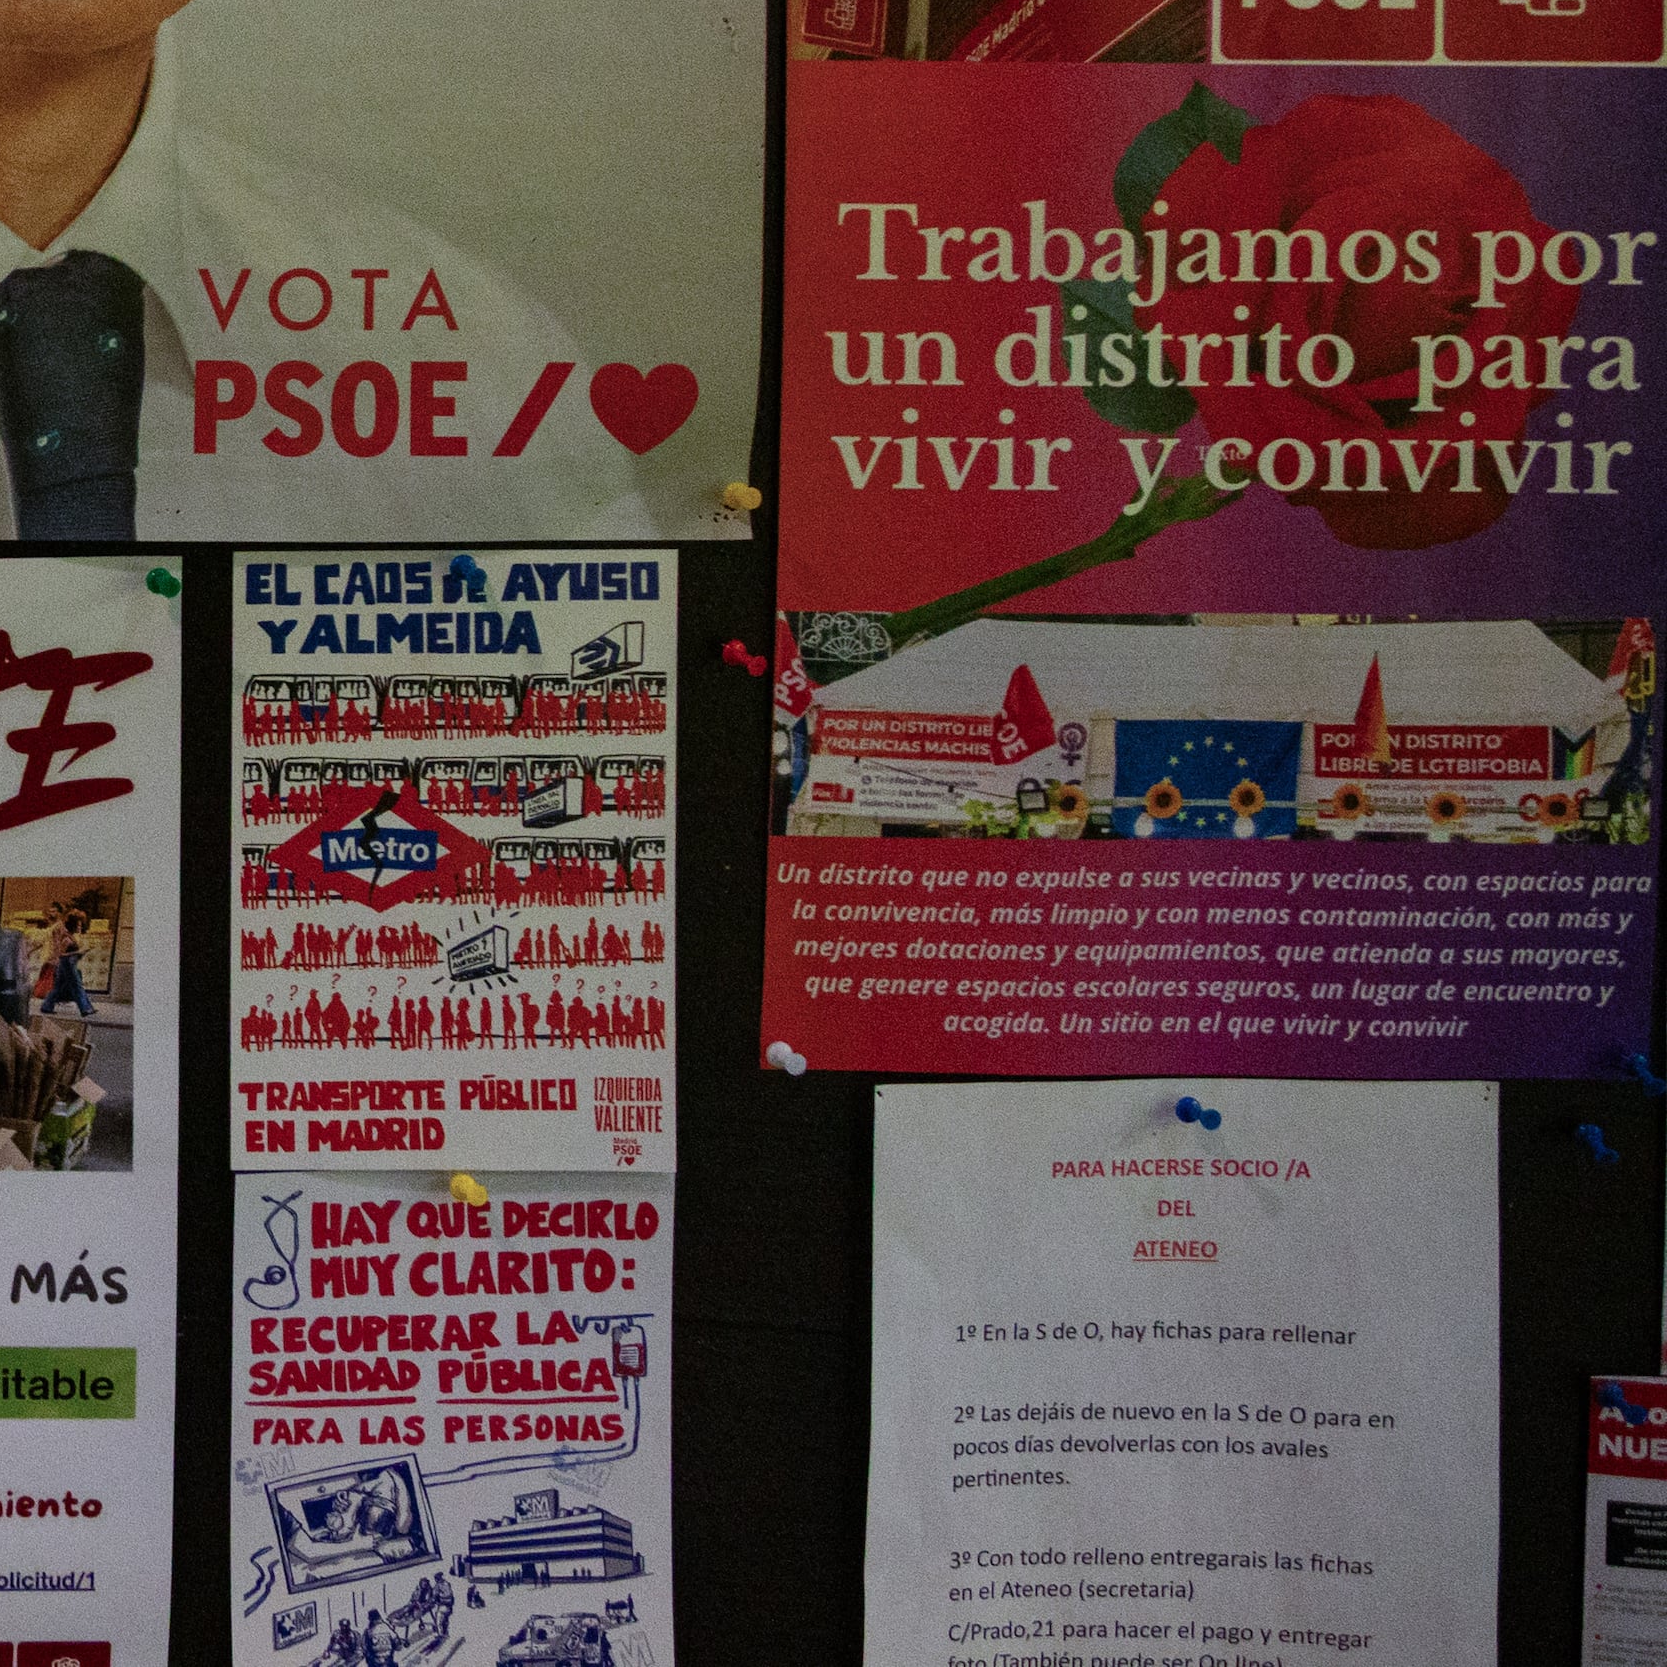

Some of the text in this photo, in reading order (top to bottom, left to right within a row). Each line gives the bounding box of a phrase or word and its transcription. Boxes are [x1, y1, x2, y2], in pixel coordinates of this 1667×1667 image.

[838, 200, 1656, 308] Trabajamos por
[199, 268, 458, 332] VOTA
[826, 304, 1641, 412] un distrito para
[196, 360, 467, 458] PSOE
[832, 408, 1632, 517] vivir y convivir
[245, 563, 301, 605] EL
[313, 562, 432, 605] CAOS
[502, 561, 660, 602] AYUSO
[823, 718, 859, 732] POR
[865, 719, 886, 733] UN
[890, 720, 966, 736] DISTRITO
[1321, 733, 1356, 747] PO
[1406, 734, 1502, 749] DISTRITO
[821, 736, 991, 756] VIOLENCIAS MACHIS
[1321, 758, 1379, 773] LIBRE
[1419, 758, 1543, 774] LGTBIFOBIA
[943, 1011, 1468, 1042] acogida. Un sitio en el que vivir y convivir
[238, 1075, 576, 1111] TRANSPORTE PÚBLICO
[594, 1077, 662, 1104] IZQUIERDA
[246, 1118, 444, 1152] EN MADRID
[594, 1105, 662, 1133] VALIENTE
[613, 1145, 642, 1155] PSOE
[1052, 1160, 1105, 1178] PARA
[1112, 1159, 1203, 1176] HACERSE
[1211, 1159, 1279, 1178] SOCIO
[312, 1200, 659, 1248] HAY QUE DECIRLO
[1157, 1200, 1195, 1217] DEL
[1133, 1241, 1218, 1262] ATENEO
[10, 1250, 128, 1304] MÁS
[311, 1248, 635, 1297] MUY CLARITO:
[251, 1310, 578, 1354] RECUPERAR LA
[983, 1324, 1007, 1342] En
[1013, 1323, 1030, 1341] la
[1036, 1323, 1047, 1340] S
[1052, 1322, 1077, 1340] de
[1083, 1322, 1104, 1342] O,
[1111, 1321, 1146, 1343] hay
[1152, 1320, 1212, 1340] fichas
[1218, 1326, 1265, 1344] para
[1273, 1325, 1356, 1345] rellenar
[250, 1352, 616, 1395] SANIDAD PÚBLICA
[253, 1414, 623, 1446] PARA LAS PERSONAS
